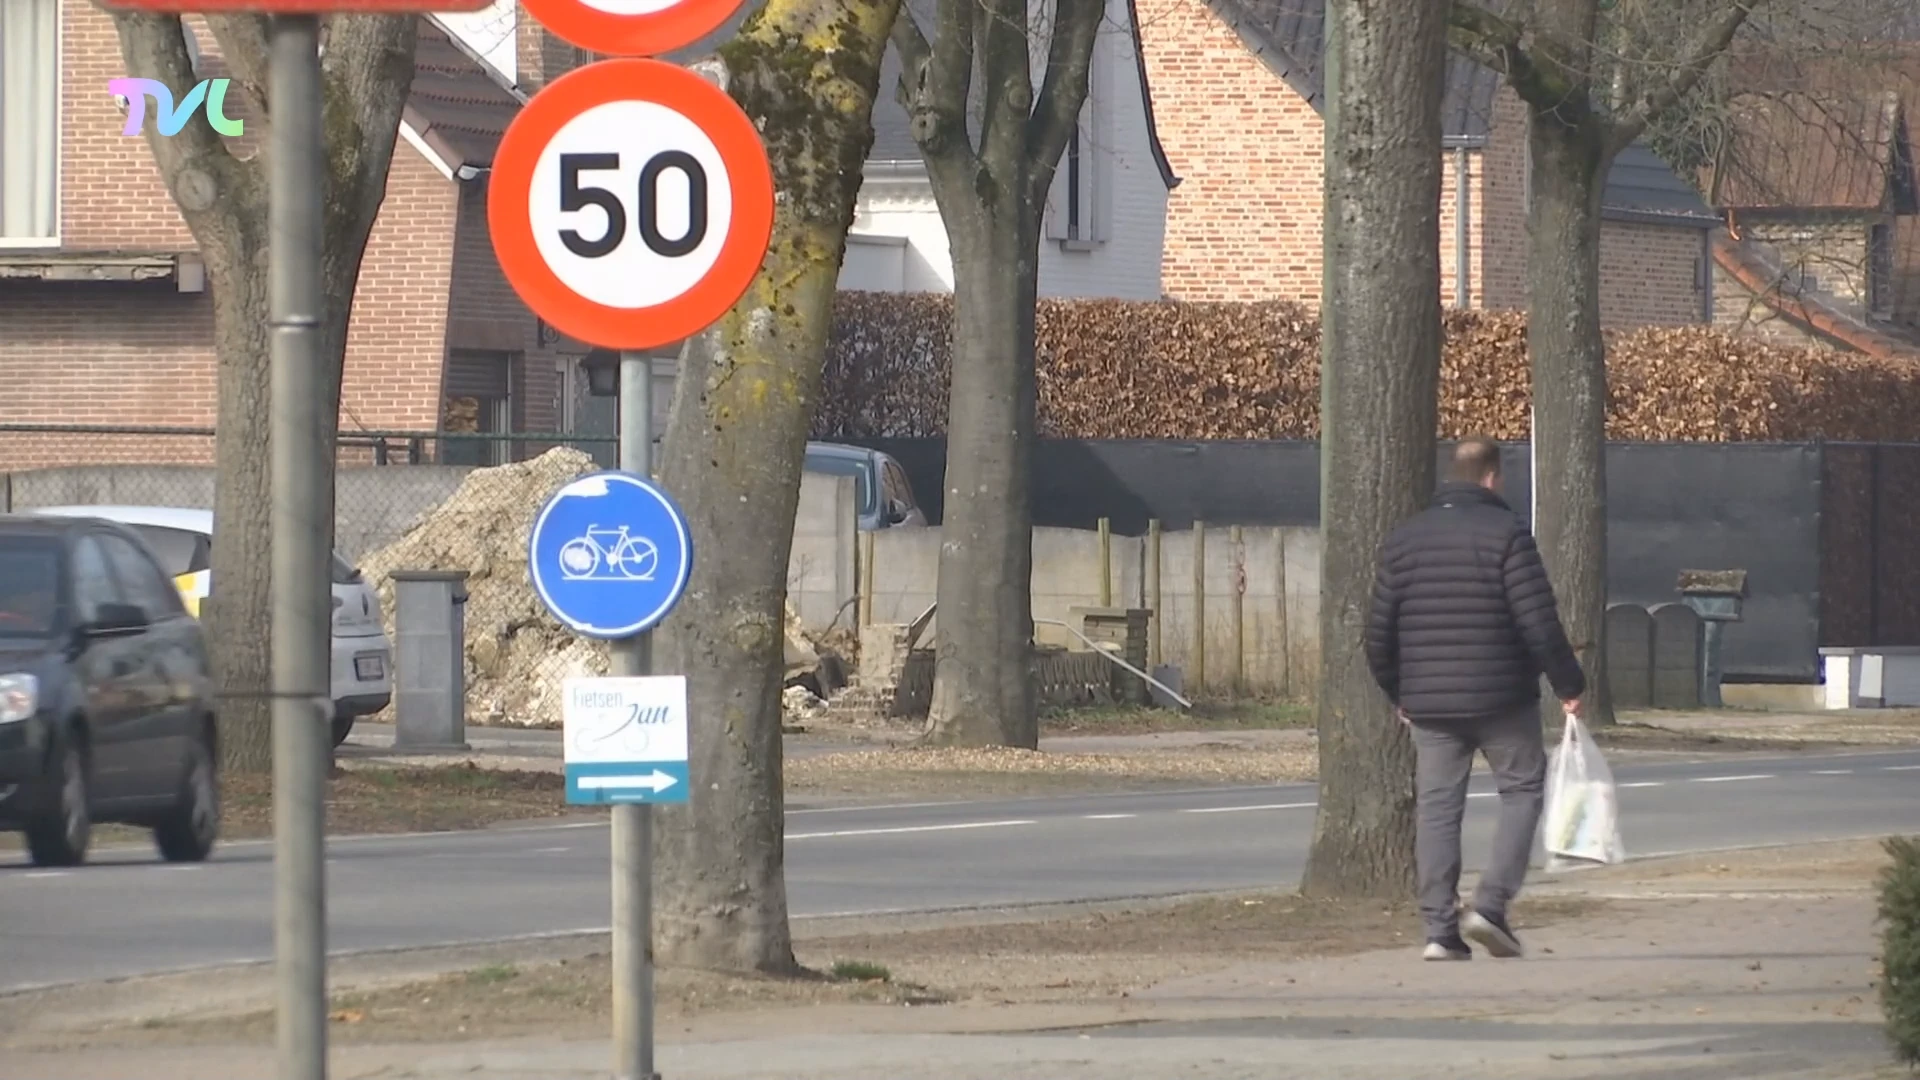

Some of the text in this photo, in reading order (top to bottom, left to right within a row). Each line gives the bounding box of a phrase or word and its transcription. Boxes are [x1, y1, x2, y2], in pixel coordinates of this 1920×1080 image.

[558, 150, 708, 258] 50
[573, 687, 623, 709] Fietsen
[593, 703, 674, 742] Jan
